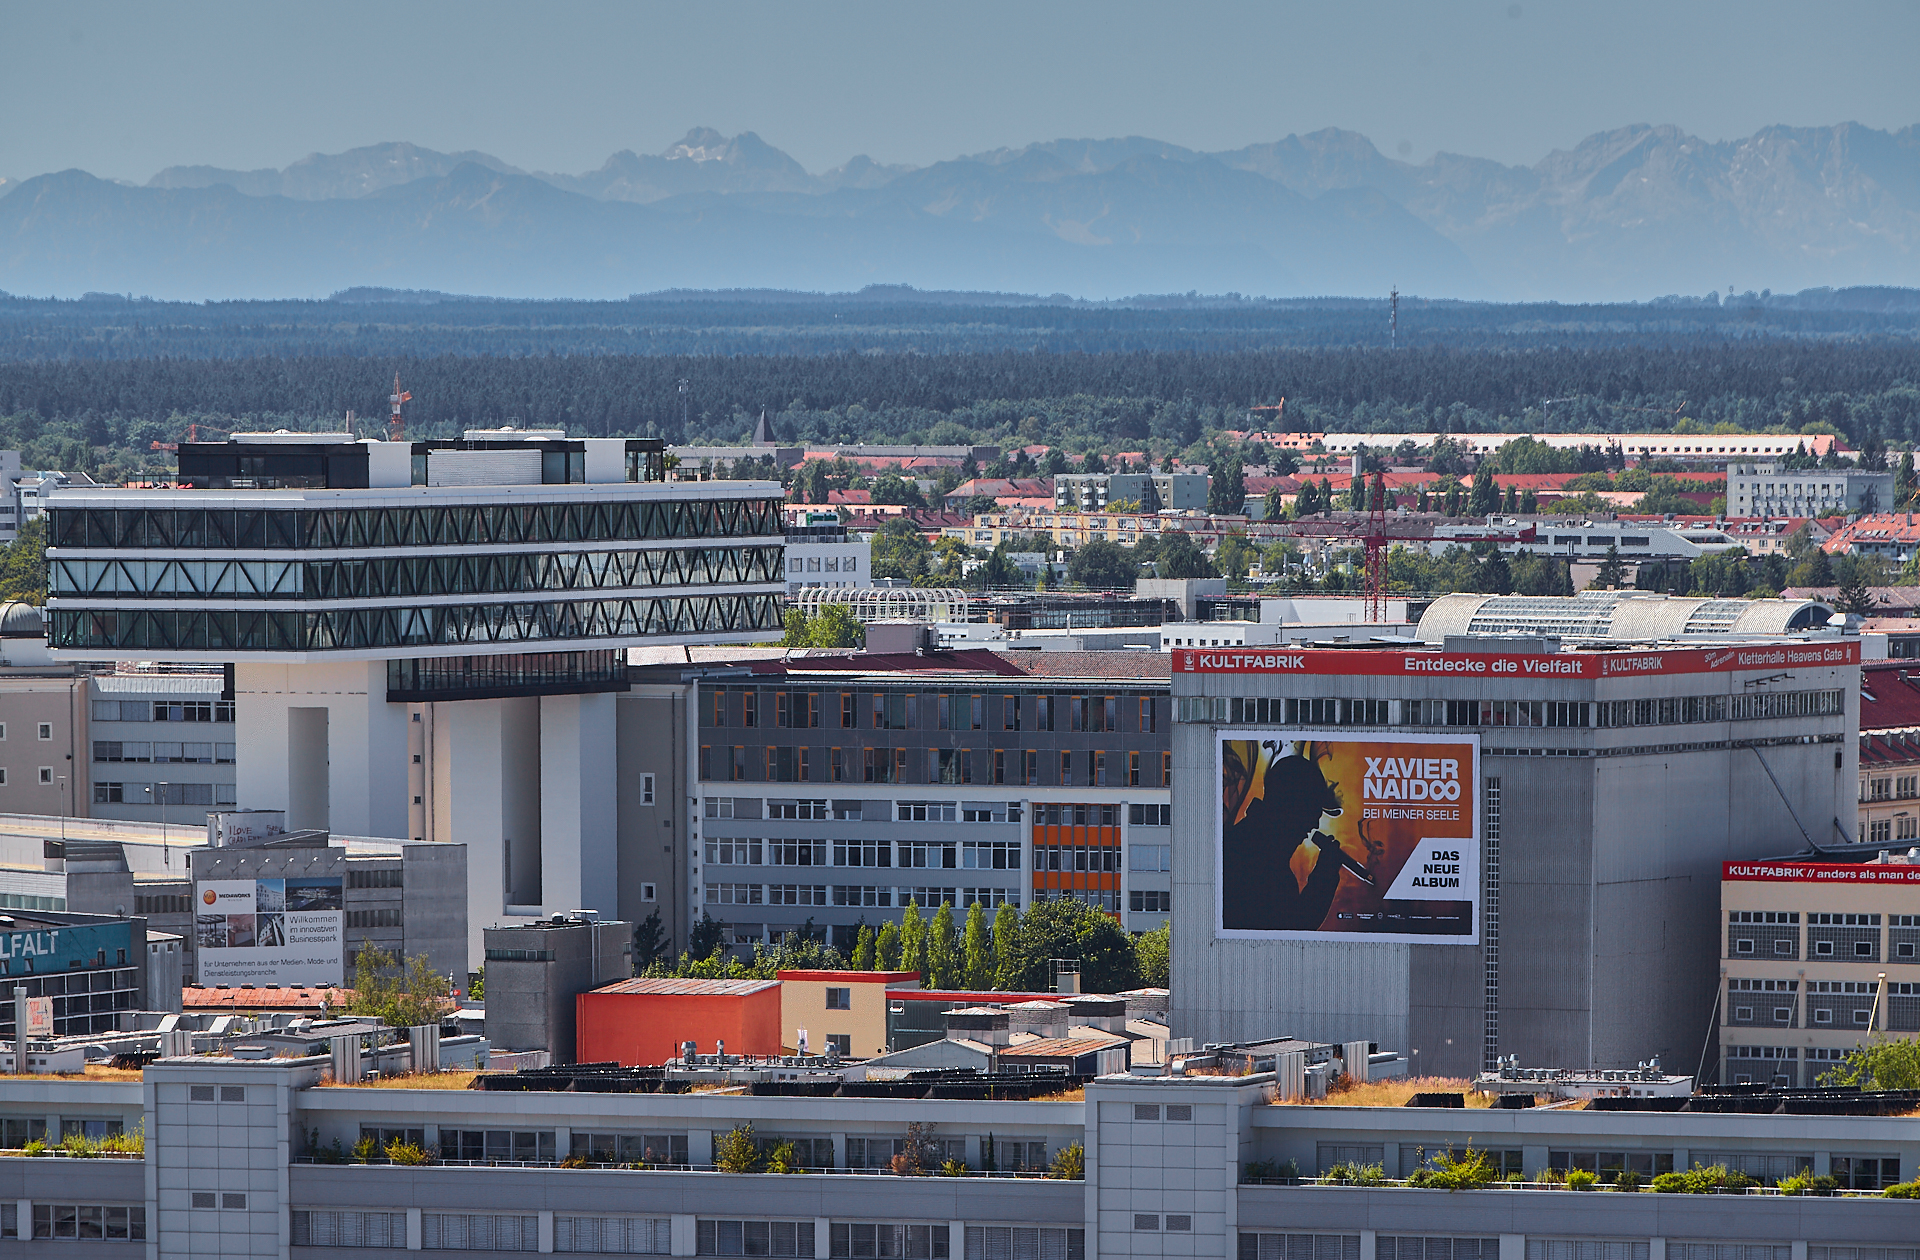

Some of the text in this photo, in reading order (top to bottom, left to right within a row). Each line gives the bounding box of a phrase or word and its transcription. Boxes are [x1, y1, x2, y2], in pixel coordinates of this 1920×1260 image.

[1200, 655, 1305, 669] KULTFABRIK
[1704, 651, 1717, 663] 30m
[1710, 651, 1735, 669] Adrenalin
[1738, 648, 1843, 665] Kletterhalle Heavens Gate
[1404, 657, 1583, 674] Entdecke die Vielfalt
[1610, 656, 1663, 672] KULTFABRIK
[1364, 757, 1459, 779] XAVIER
[1363, 808, 1460, 821] BEI MEINER SEELE
[233, 825, 252, 836] LOVE
[1432, 851, 1460, 861] DAS
[1423, 864, 1460, 874] NEUE
[1729, 865, 1804, 878] KULTFABRIK
[1817, 869, 1857, 879] anders
[1859, 870, 1876, 879] als
[1878, 871, 1904, 880] man
[1412, 877, 1460, 888] ALBUM
[289, 915, 338, 924] Willkommen
[299, 925, 338, 933] innovativen
[0, 931, 59, 959] LFALT
[289, 935, 337, 945] Businesspark
[214, 960, 256, 968] Unternehmen
